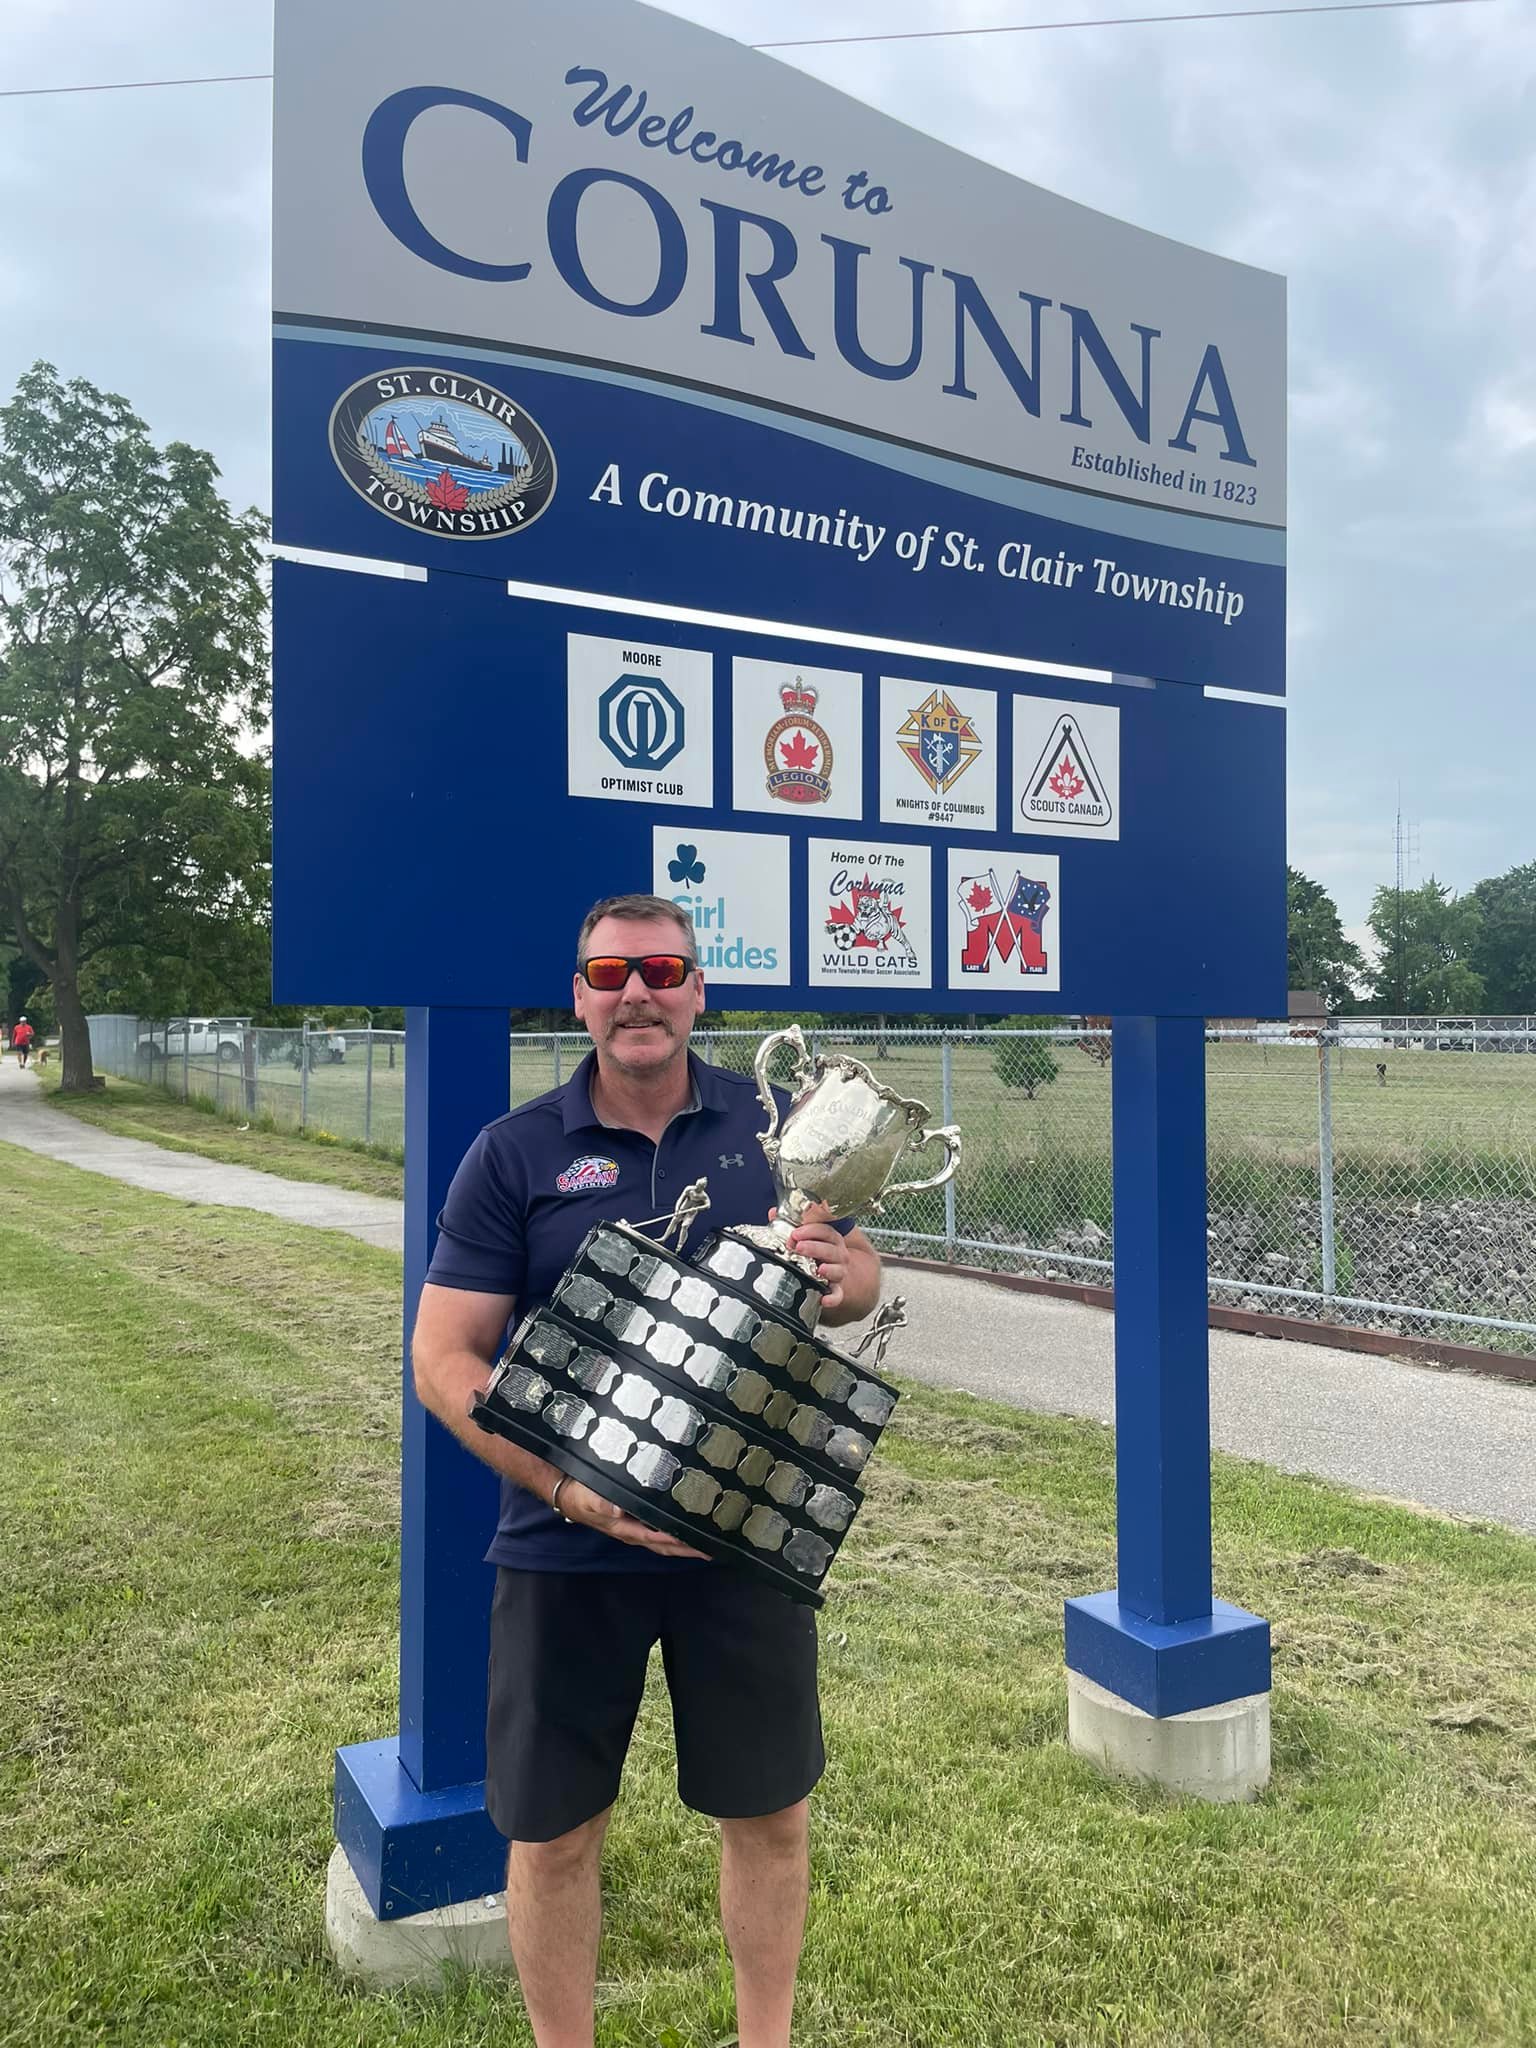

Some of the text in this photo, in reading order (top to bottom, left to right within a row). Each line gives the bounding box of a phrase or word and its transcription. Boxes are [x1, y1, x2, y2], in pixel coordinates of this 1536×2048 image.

[565, 65, 893, 215] Welcome to
[362, 85, 1257, 468] CORUNNA
[377, 375, 516, 425] ST. CLAIR
[1071, 446, 1258, 506] Established in 1823
[365, 475, 526, 533] TOWNSHIP
[590, 463, 1245, 625] A Community of St. Clair Township
[622, 650, 662, 666] MOORE
[921, 714, 959, 731] K OF C
[601, 777, 684, 796] OPTIMIST CLUB
[774, 773, 825, 788] LEGION
[896, 798, 985, 815] KNIGHTS OF COLUMBUS
[1030, 799, 1104, 816] SCOUTS CANADA
[928, 812, 954, 822] #9447
[830, 851, 905, 867] Home Of The
[829, 869, 906, 897] Corunna
[696, 933, 778, 969] uides
[823, 953, 918, 968] WILD CATS
[838, 967, 860, 975] Township
